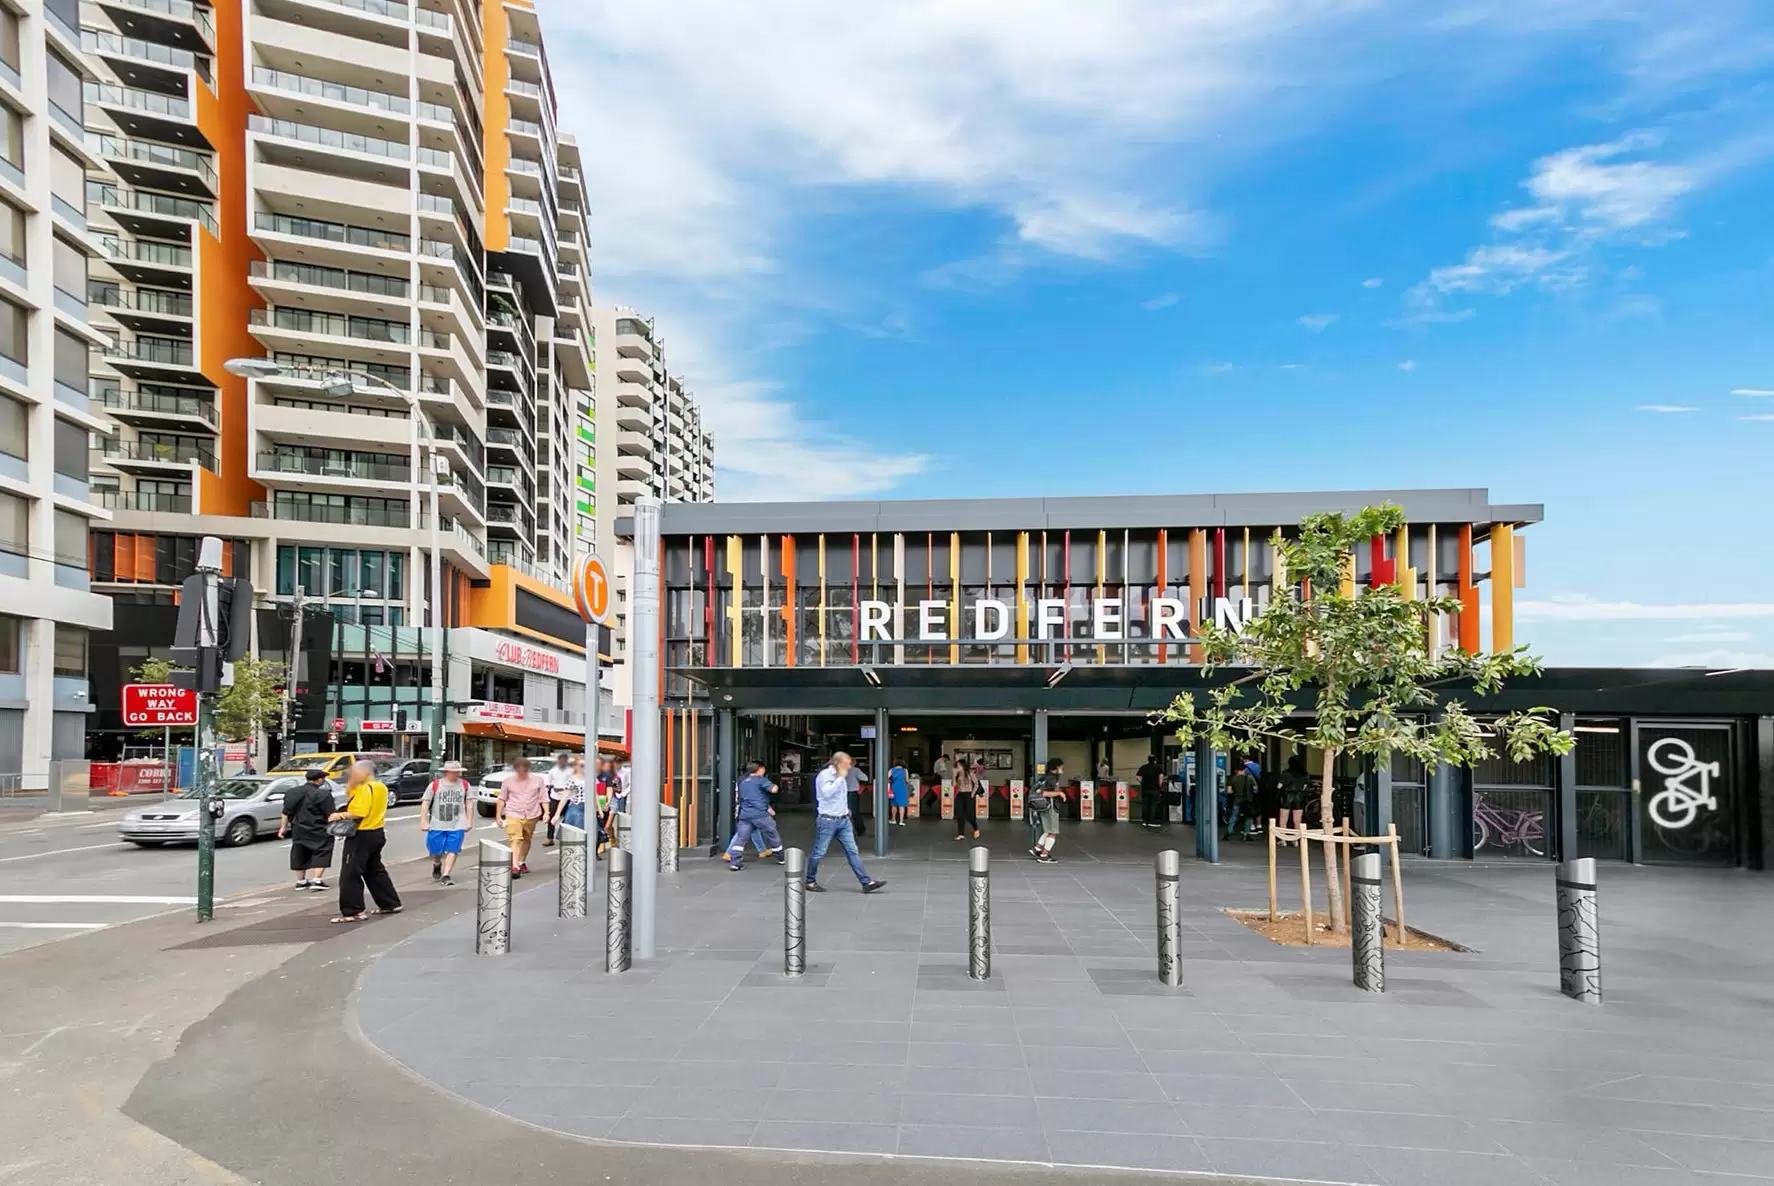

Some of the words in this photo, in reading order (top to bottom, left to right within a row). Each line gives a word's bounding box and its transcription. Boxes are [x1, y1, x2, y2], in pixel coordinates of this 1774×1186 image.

[590, 570, 603, 608] T
[860, 597, 1252, 641] REDFERN
[138, 688, 186, 697] WRONG
[147, 699, 175, 708] WAY
[129, 712, 148, 721] GO
[157, 712, 193, 721] BACK
